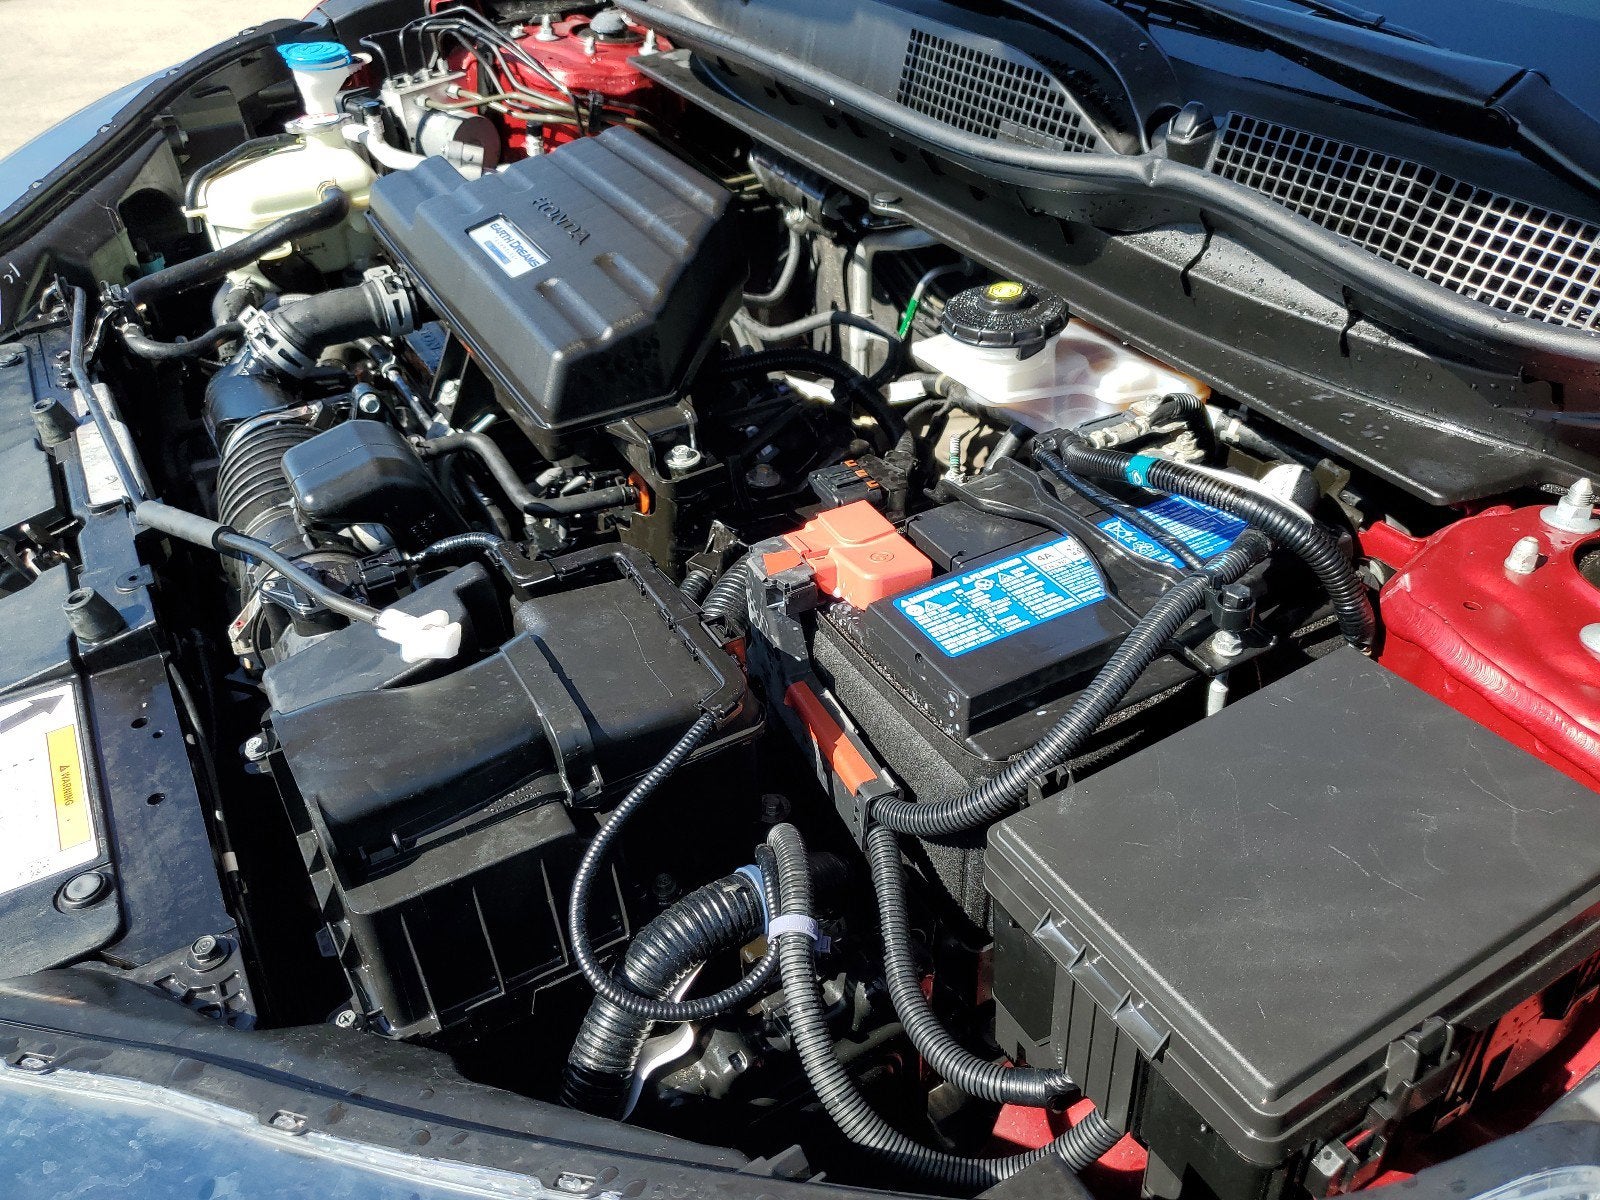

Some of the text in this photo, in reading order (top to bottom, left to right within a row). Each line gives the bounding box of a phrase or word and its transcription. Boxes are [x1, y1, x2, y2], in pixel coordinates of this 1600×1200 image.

[532, 197, 590, 245] HONDA
[490, 222, 513, 245] EARTH
[509, 240, 540, 267] DREAMS
[61, 772, 74, 806] WARNING
